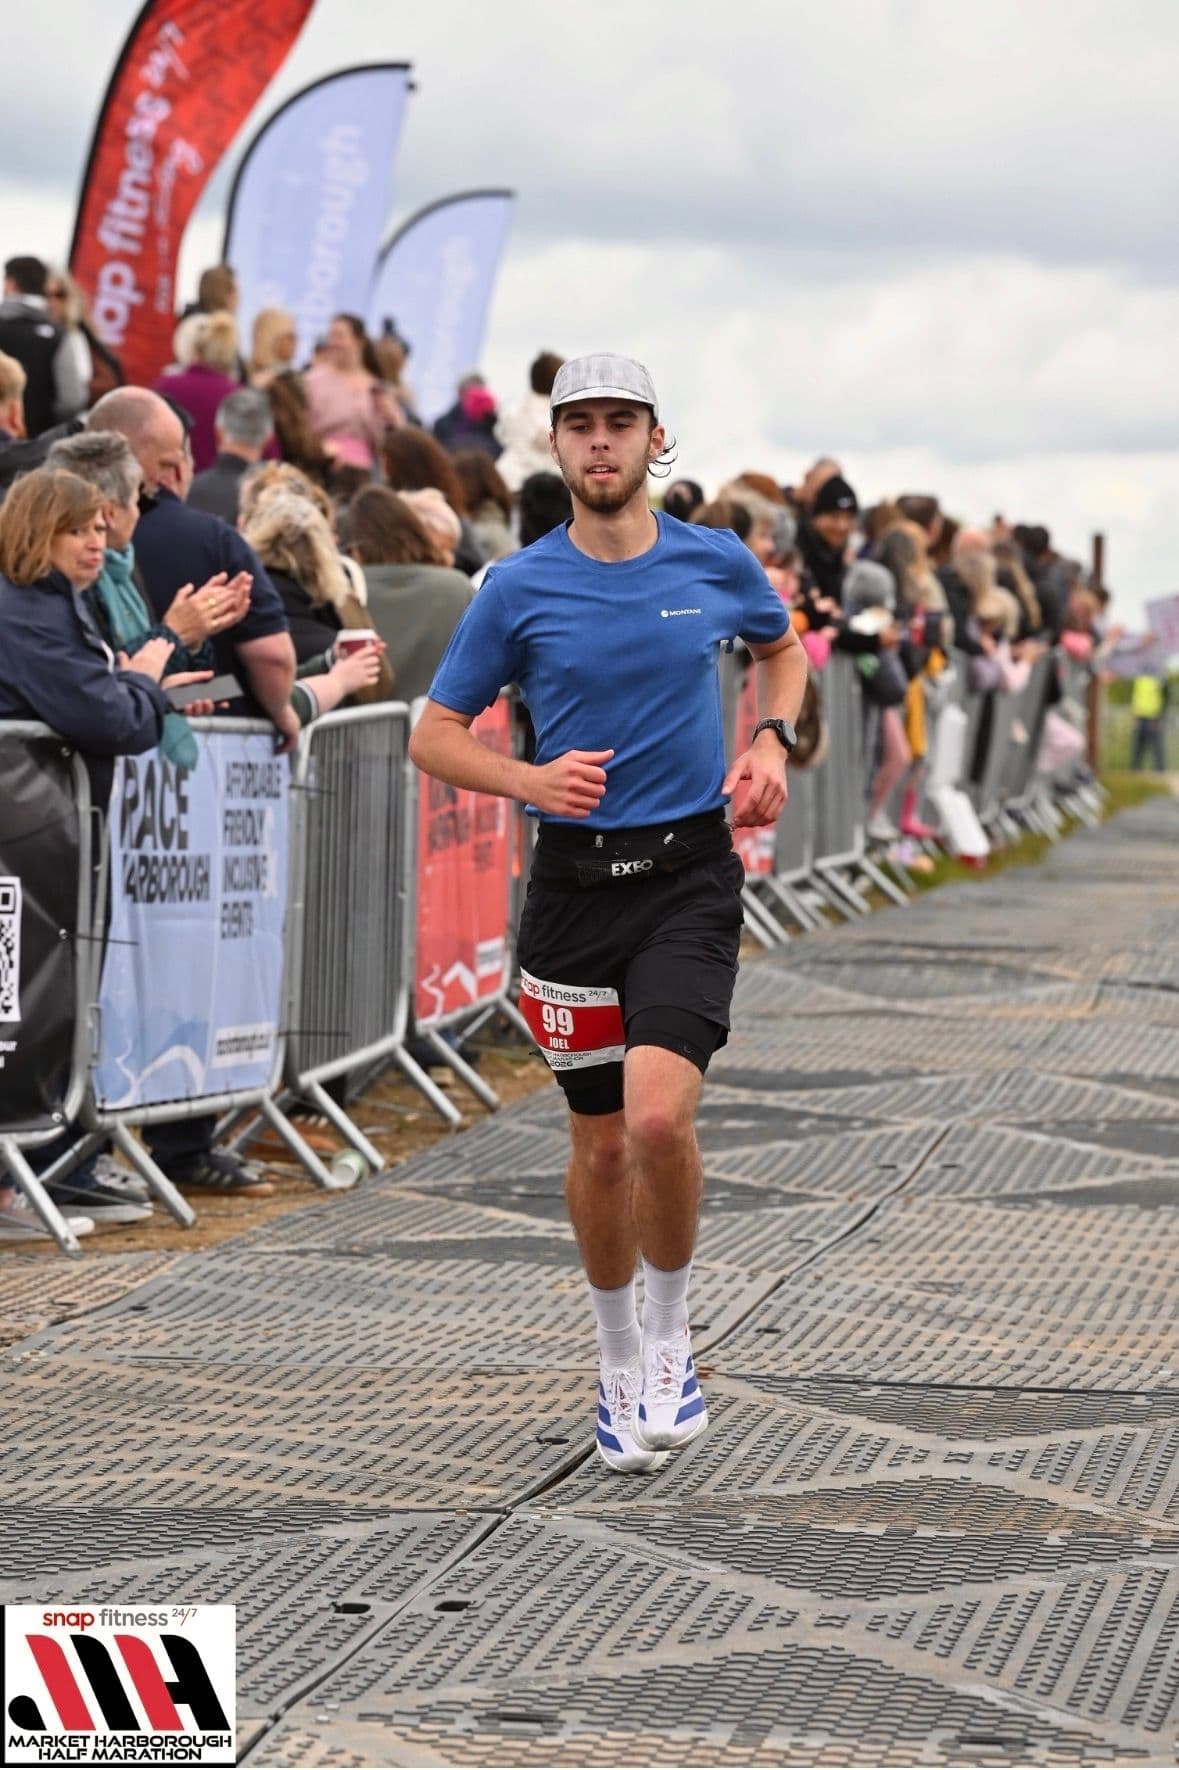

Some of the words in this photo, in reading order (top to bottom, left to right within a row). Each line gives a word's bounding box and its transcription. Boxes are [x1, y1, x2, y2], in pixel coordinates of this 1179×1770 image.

[97, 90, 172, 256] fitness
[120, 757, 189, 850] RACE
[611, 859, 653, 877] EXEO
[542, 984, 587, 1003] fitness
[541, 1003, 575, 1036] 99
